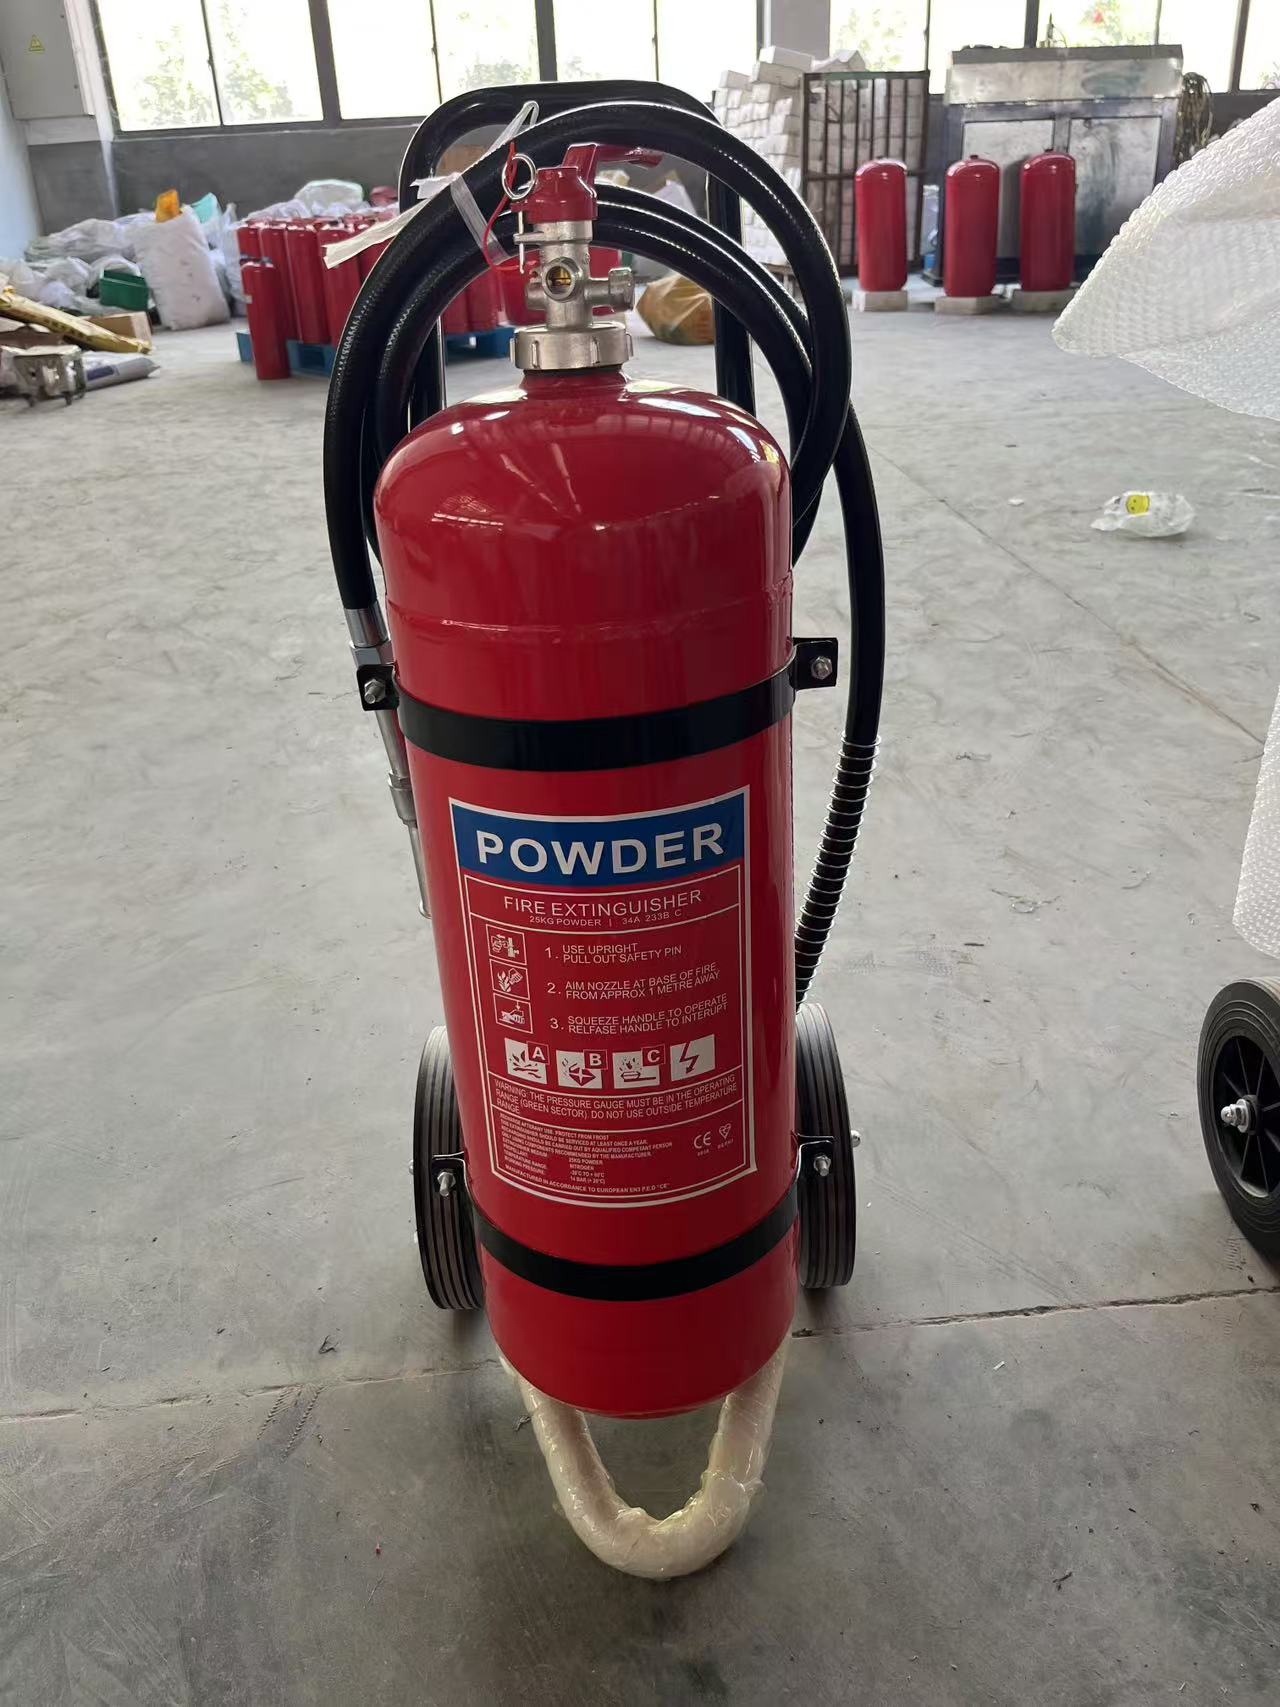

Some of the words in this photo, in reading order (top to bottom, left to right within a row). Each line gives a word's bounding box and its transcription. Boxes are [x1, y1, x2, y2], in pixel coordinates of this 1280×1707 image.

[476, 822, 725, 875] POWDER
[504, 896, 546, 915] FIRE
[552, 890, 702, 917] EXTINGUISHER
[529, 915, 554, 925] 25KG
[556, 918, 601, 927] POWDER
[622, 916, 640, 925] 34A
[645, 912, 670, 922] 233B
[674, 909, 682, 917] C
[545, 947, 559, 959] 1.
[562, 944, 585, 954] USE
[588, 942, 638, 954] UPRIGHT
[563, 954, 589, 964] PULL
[593, 954, 616, 964] OUT
[619, 950, 662, 963] SAFETY
[664, 945, 682, 957] PIN
[547, 982, 561, 995] 2.
[565, 981, 585, 991] AIM
[588, 980, 633, 991] NOZZLE
[633, 978, 646, 988] AT
[649, 973, 677, 987] BASE
[679, 969, 694, 980] OF
[696, 962, 717, 977] FIRE
[565, 990, 598, 1000] FROM
[600, 988, 646, 1000] APPROX
[649, 987, 655, 996] 1
[657, 978, 694, 995] METRE
[694, 970, 720, 986] AWAY
[550, 1017, 564, 1030] 3.
[567, 1015, 619, 1026] SQUEEZE
[622, 1011, 665, 1025] HANDLE
[668, 1008, 682, 1018] TO
[684, 993, 728, 1014] OPERATE
[568, 1025, 617, 1035] RELFASE
[619, 1022, 663, 1034] HANDLE
[665, 1017, 680, 1029] TO
[682, 1001, 728, 1025] INTERUPT
[531, 1046, 546, 1061] A
[588, 1053, 603, 1066] B
[647, 1049, 661, 1062] C
[495, 1088, 520, 1104] RANGE
[520, 1098, 549, 1113] (GREEN
[591, 1110, 605, 1119] DO
[606, 1110, 624, 1119] NOT
[626, 1109, 644, 1118] USE
[645, 1102, 683, 1116] OUTSIDE
[685, 1083, 737, 1109] TEMPERATURE
[529, 1091, 545, 1103] THE
[547, 1096, 592, 1109] PRESSURE
[593, 1100, 624, 1109] GAUGE
[626, 1097, 651, 1109] MUST
[652, 1095, 664, 1106] BE
[666, 1092, 675, 1103] IN
[676, 1088, 692, 1101] THE
[693, 1074, 736, 1096] OPERATING
[496, 1099, 520, 1115] RANGE
[694, 1131, 712, 1149] CE
